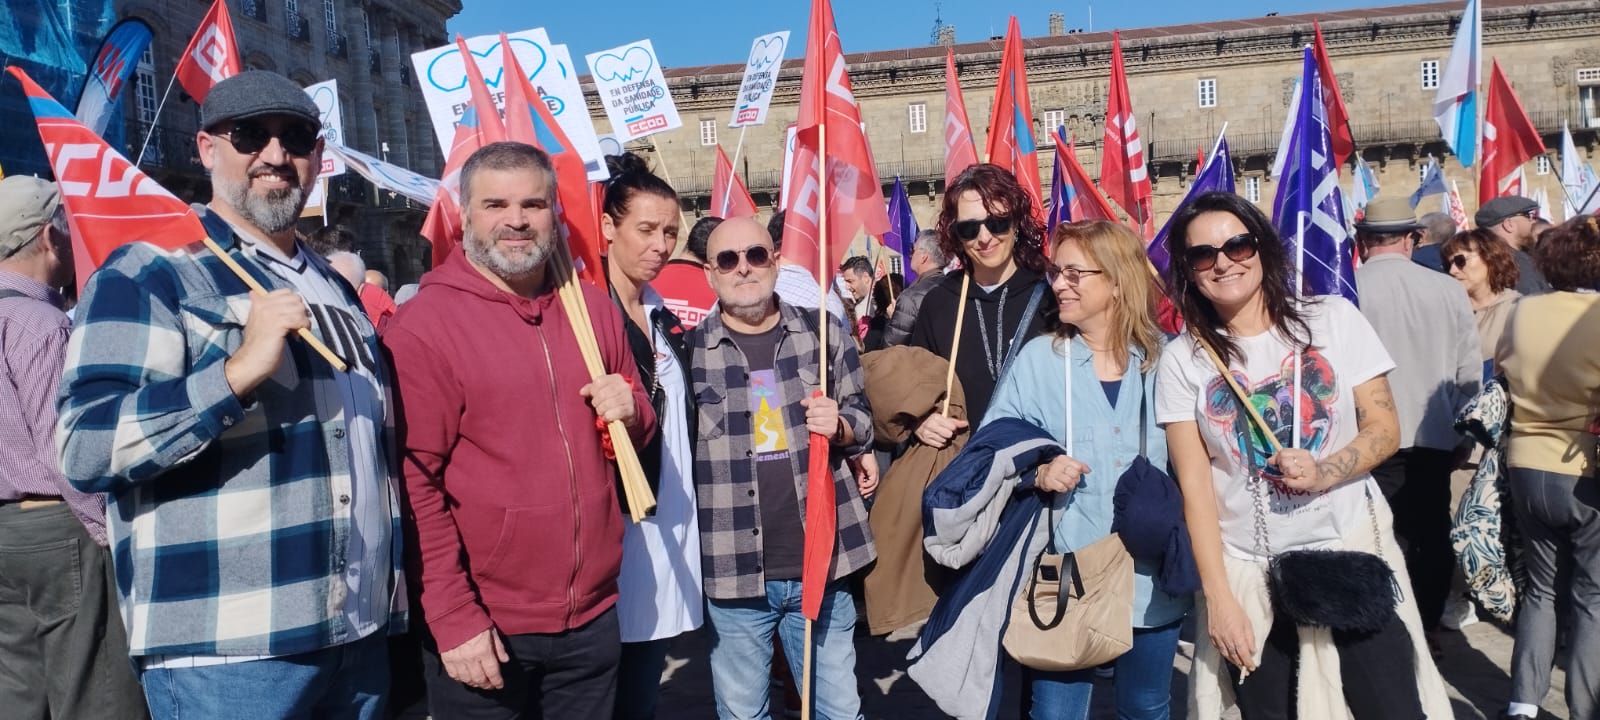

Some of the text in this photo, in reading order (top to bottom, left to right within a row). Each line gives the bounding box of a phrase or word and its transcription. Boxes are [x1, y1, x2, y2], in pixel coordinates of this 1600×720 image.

[610, 79, 655, 97] EN DEFENSA
[612, 88, 662, 108] DA SANIDADE
[623, 100, 656, 115] PÚBLICA
[628, 116, 666, 135] CCOO
